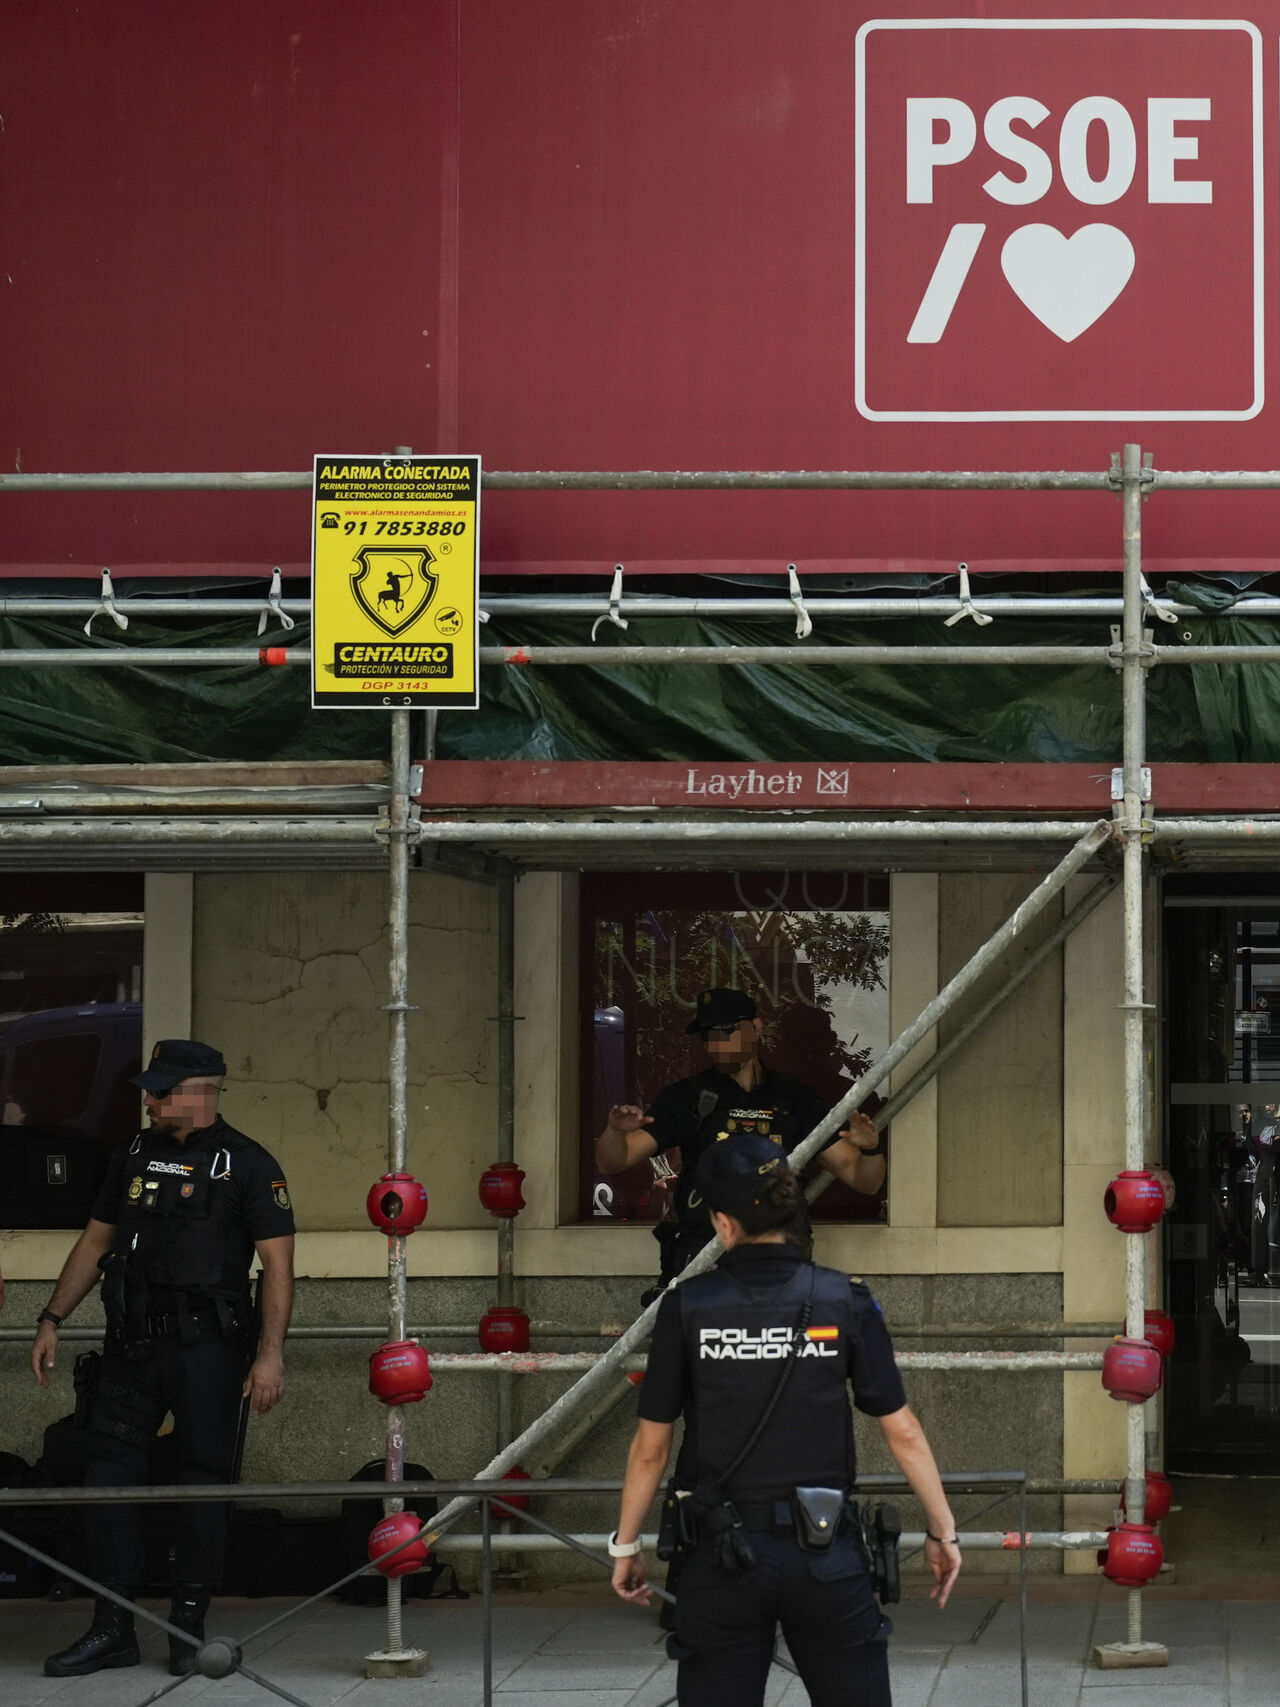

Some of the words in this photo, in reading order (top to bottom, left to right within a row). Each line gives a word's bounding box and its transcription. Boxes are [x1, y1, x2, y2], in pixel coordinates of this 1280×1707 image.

[906, 95, 1213, 206] PSOE
[319, 465, 382, 480] ALARMA
[384, 465, 471, 480] CONECTADA
[319, 482, 367, 491] PERIMETRO
[367, 482, 415, 491] PROTEGIDO
[416, 482, 436, 491] CON
[436, 483, 471, 491] SISTEMA
[334, 491, 392, 499] ELECTRONICO
[393, 491, 404, 499] DE
[406, 491, 454, 499] SEGURIDAD
[344, 509, 468, 517] www.alarmasenandamios.es
[343, 521, 368, 537] 91
[375, 521, 466, 537] 7853880
[339, 646, 448, 663] CENTAURO
[340, 663, 393, 674] PROTECCIÓN
[393, 665, 399, 674] Y
[400, 665, 448, 674] SEGURIDAD
[362, 681, 394, 690] DGP
[396, 681, 429, 690] 3143
[686, 769, 803, 799] Layher
[147, 1165, 191, 1176] NACIONAL
[149, 1160, 186, 1170] POLICIA
[700, 1341, 838, 1360] NACIONAL
